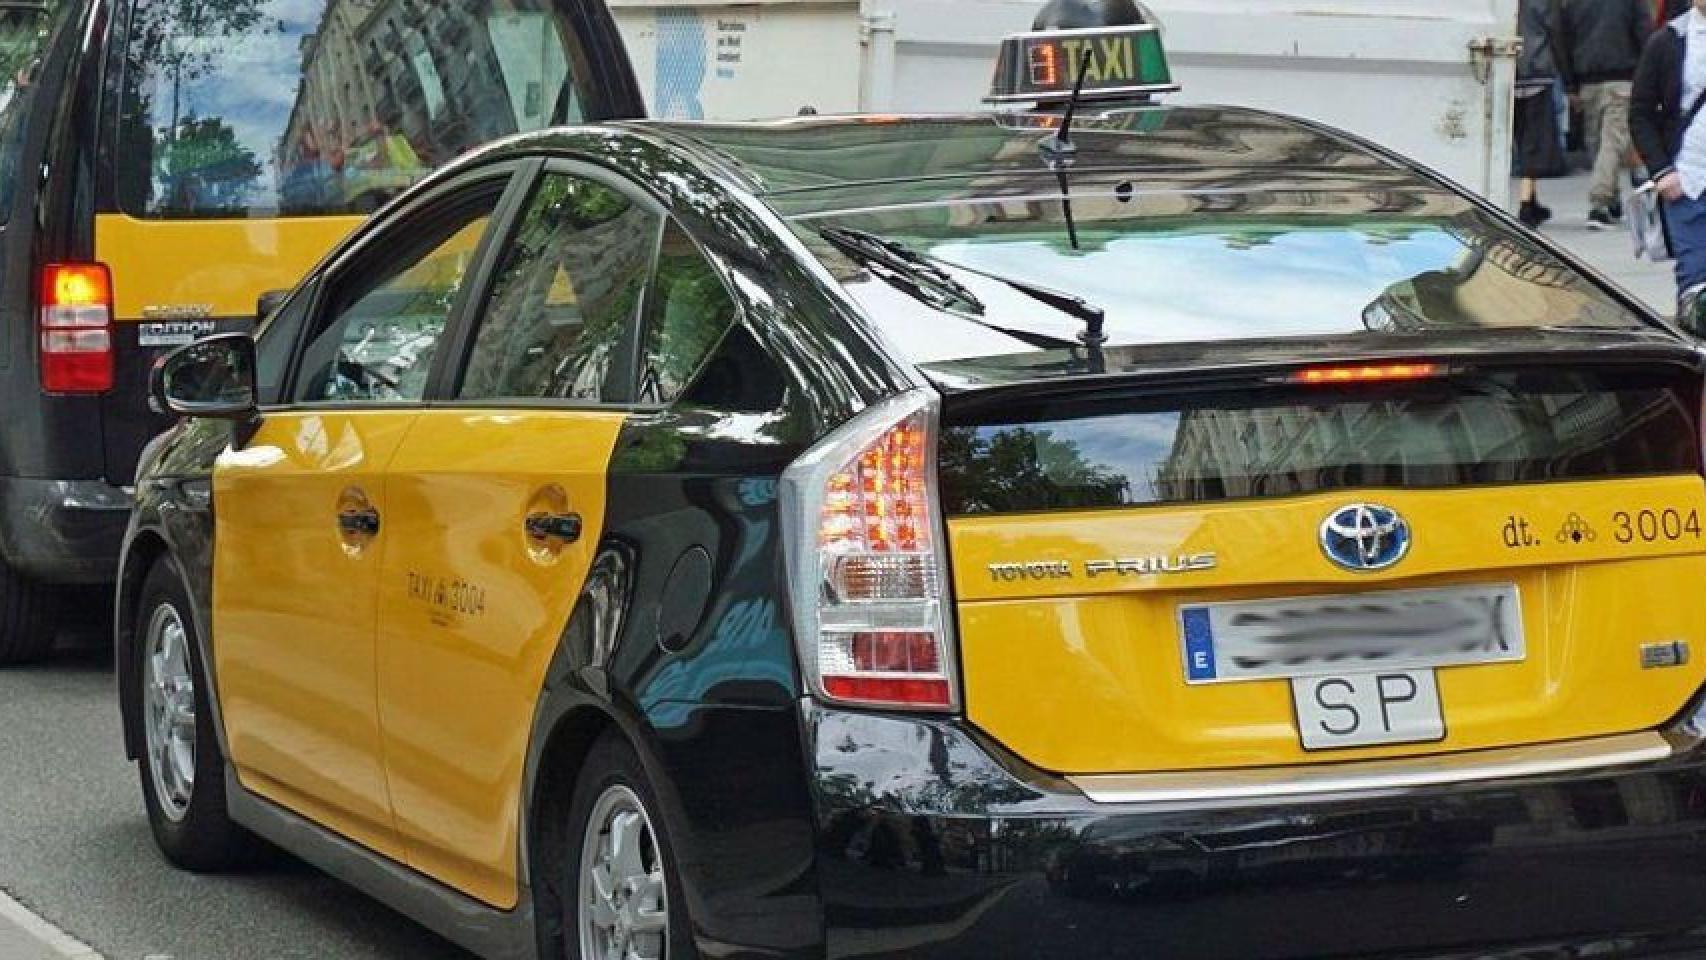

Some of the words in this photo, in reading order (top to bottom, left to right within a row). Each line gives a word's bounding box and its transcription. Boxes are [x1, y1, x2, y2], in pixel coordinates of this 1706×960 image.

[1062, 37, 1133, 82] TAXI
[1503, 515, 1541, 548] dt.
[1613, 507, 1702, 545] 3004
[988, 560, 1072, 581] TOYOTA
[1085, 552, 1216, 578] PRIUS
[407, 571, 433, 604] TAXI
[451, 579, 486, 616] 3004
[1194, 651, 1208, 668] E
